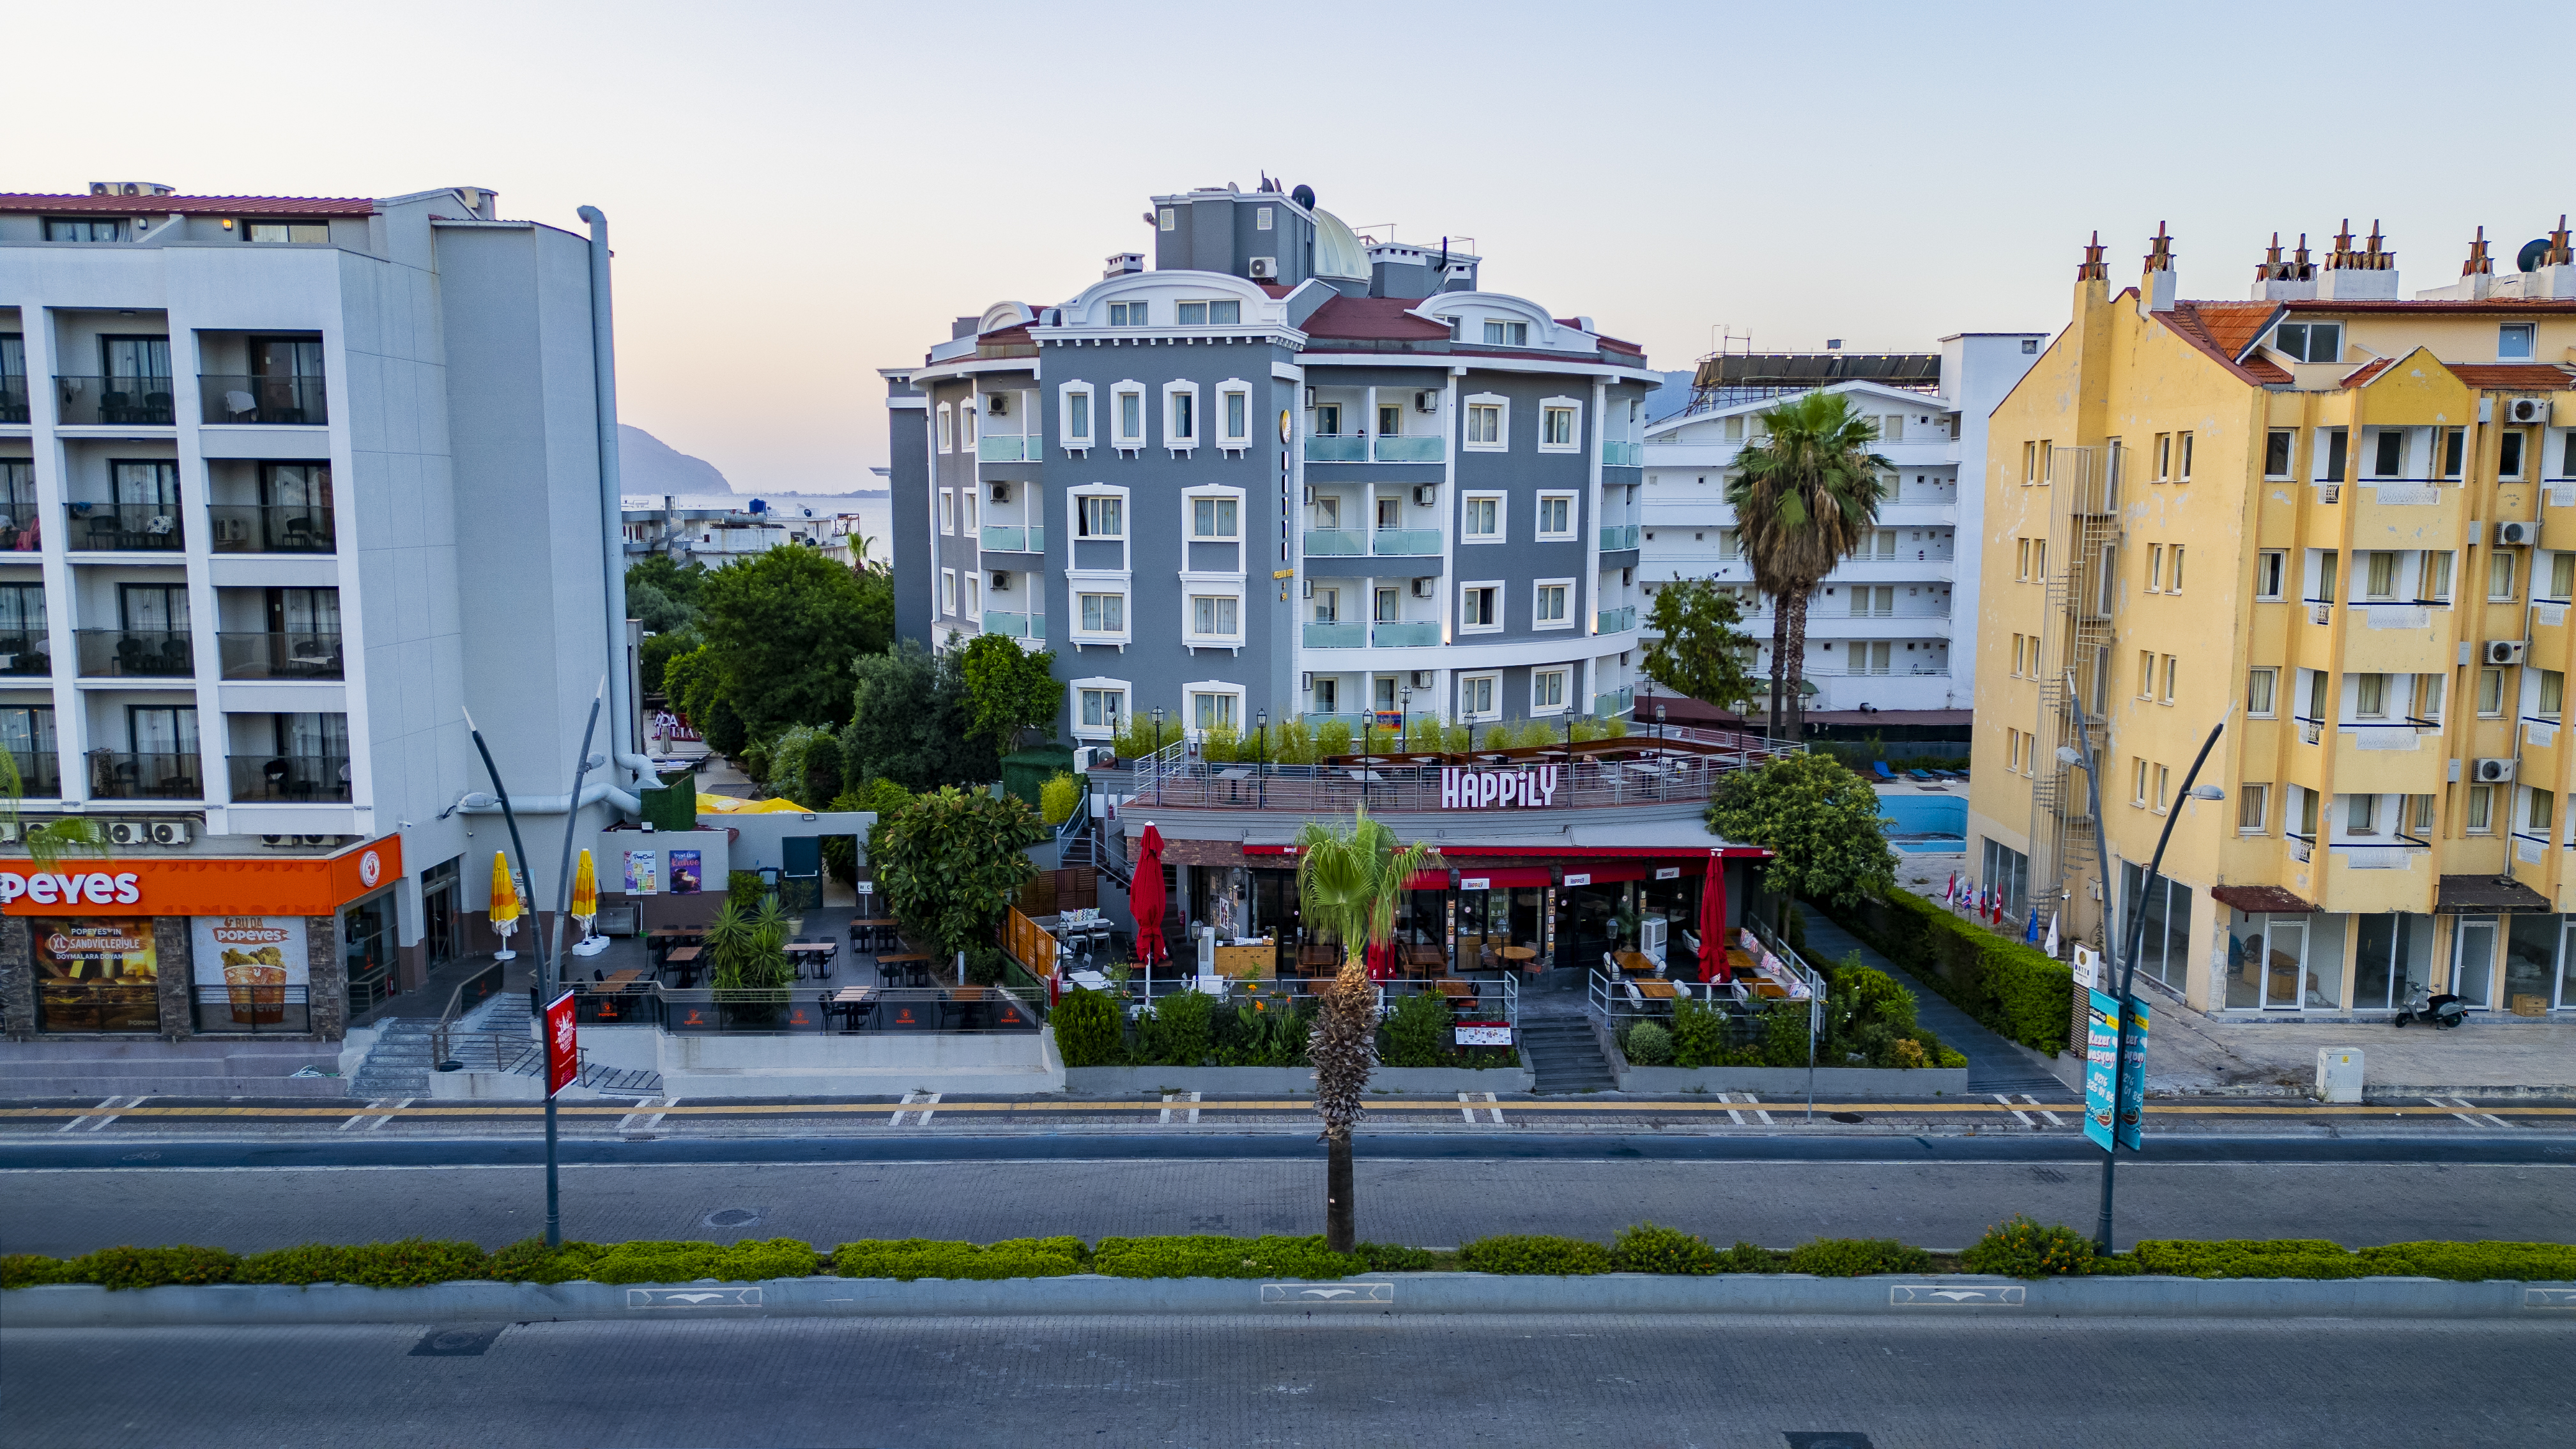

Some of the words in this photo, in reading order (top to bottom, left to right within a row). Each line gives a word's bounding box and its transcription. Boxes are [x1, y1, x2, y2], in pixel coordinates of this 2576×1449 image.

[2087, 1078, 2098, 1093] 325
[2094, 1071, 2108, 1087] 0216
[2122, 1073, 2135, 1086] 216
